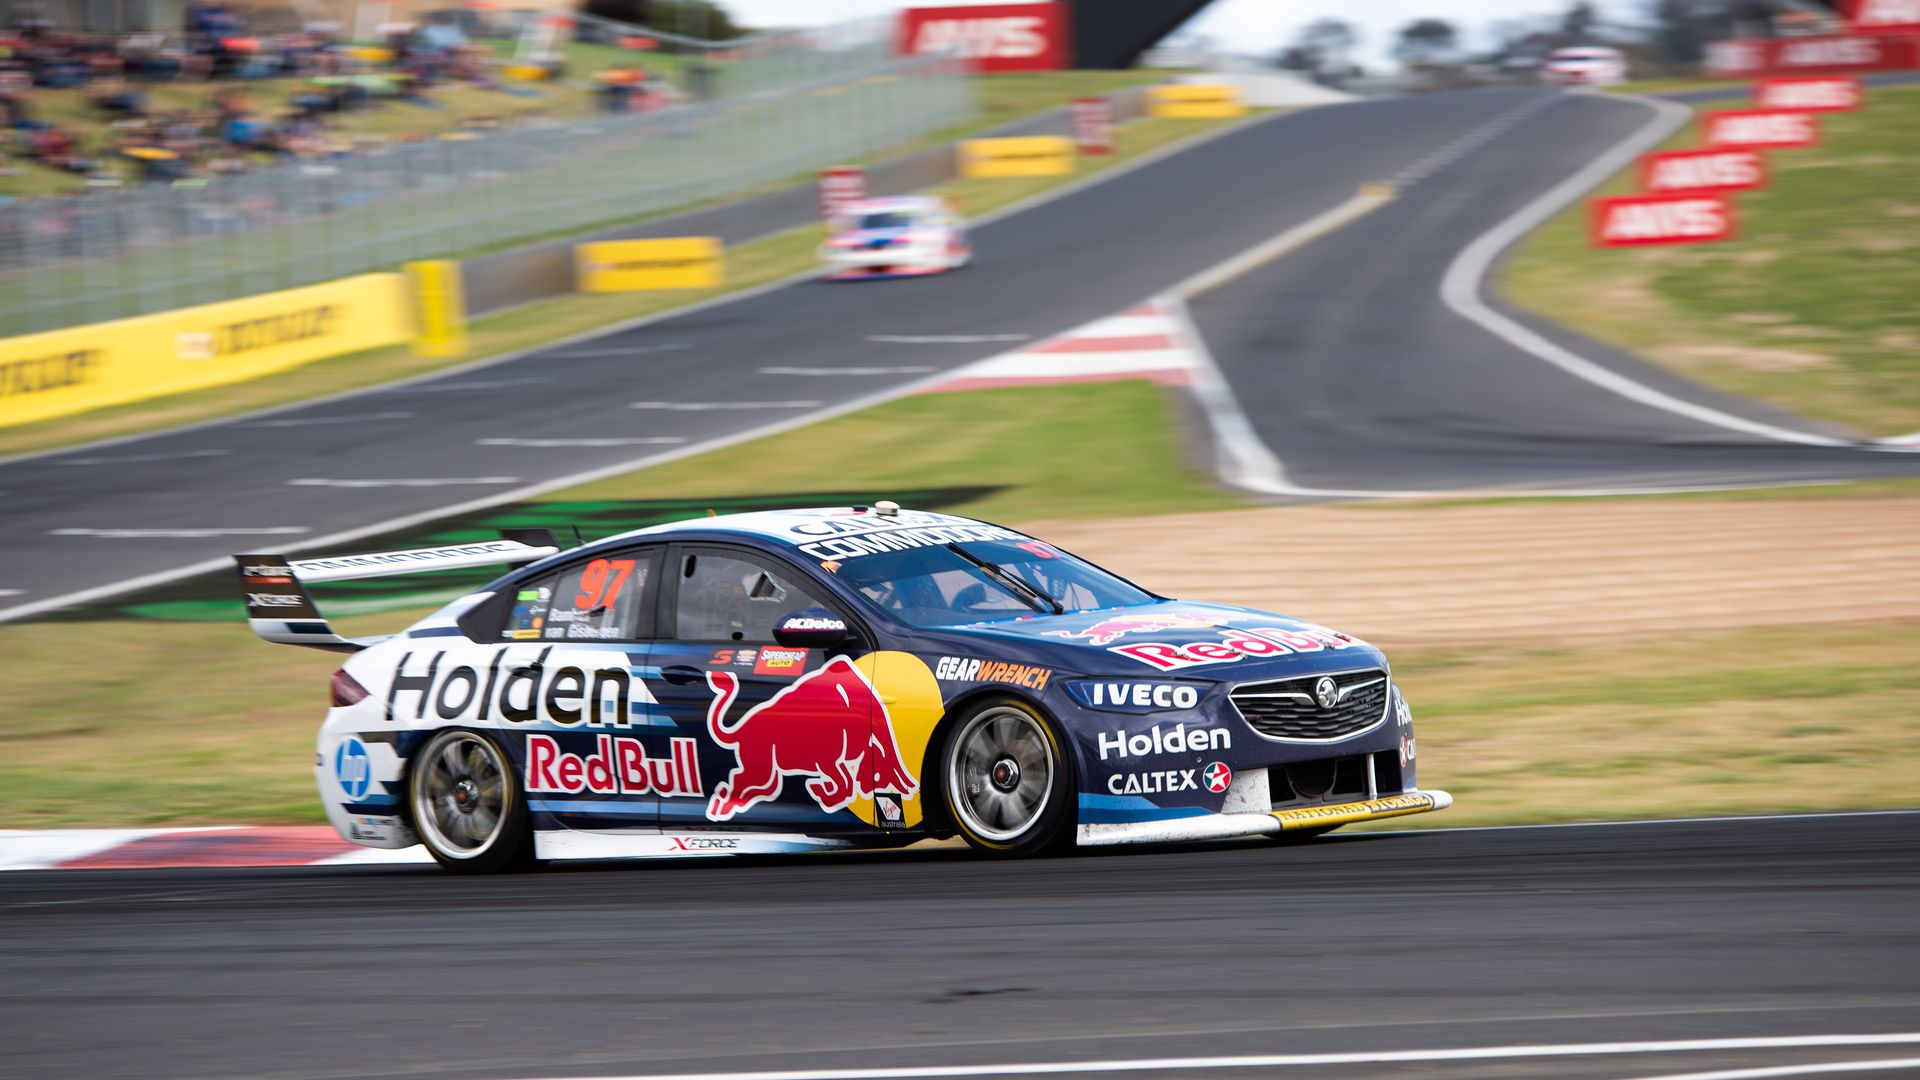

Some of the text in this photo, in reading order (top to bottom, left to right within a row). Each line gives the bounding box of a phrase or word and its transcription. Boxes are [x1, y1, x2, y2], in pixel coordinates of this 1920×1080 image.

[797, 524, 1031, 561] COMMODORE
[575, 558, 637, 609] 97
[783, 617, 846, 630] ACDelco
[385, 645, 632, 727] Holden
[1092, 682, 1198, 709] IVECO
[1097, 723, 1232, 761] Holden
[1107, 769, 1199, 795] CALTEX
[1281, 802, 1366, 821] NATIONAL
